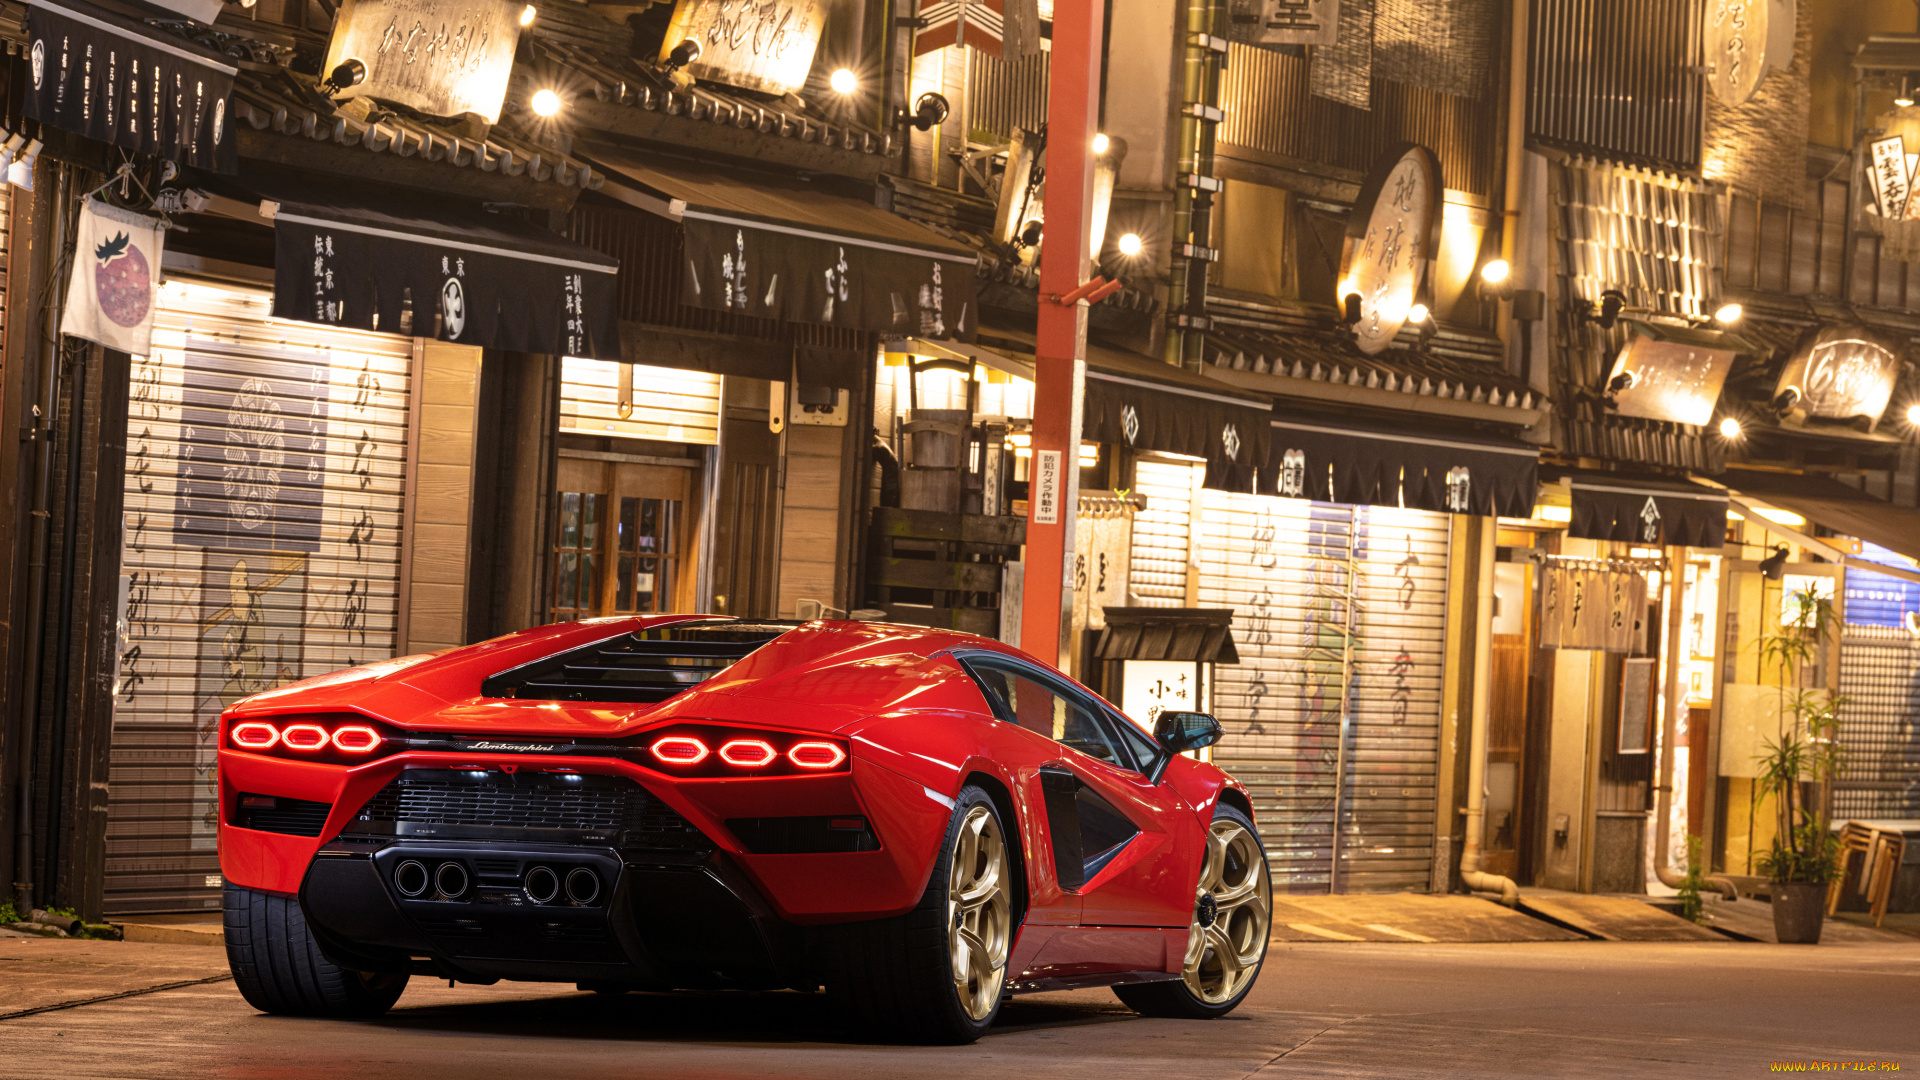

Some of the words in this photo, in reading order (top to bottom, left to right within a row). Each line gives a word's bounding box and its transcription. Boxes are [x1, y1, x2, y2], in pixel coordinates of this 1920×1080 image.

[325, 235, 338, 323] 東京都
[441, 255, 465, 277] 東京
[564, 275, 576, 355] 三年四月
[1041, 455, 1055, 514] 防犯カメラ作動中
[1176, 673, 1189, 700] 十味
[466, 741, 555, 751] Lamborghini
